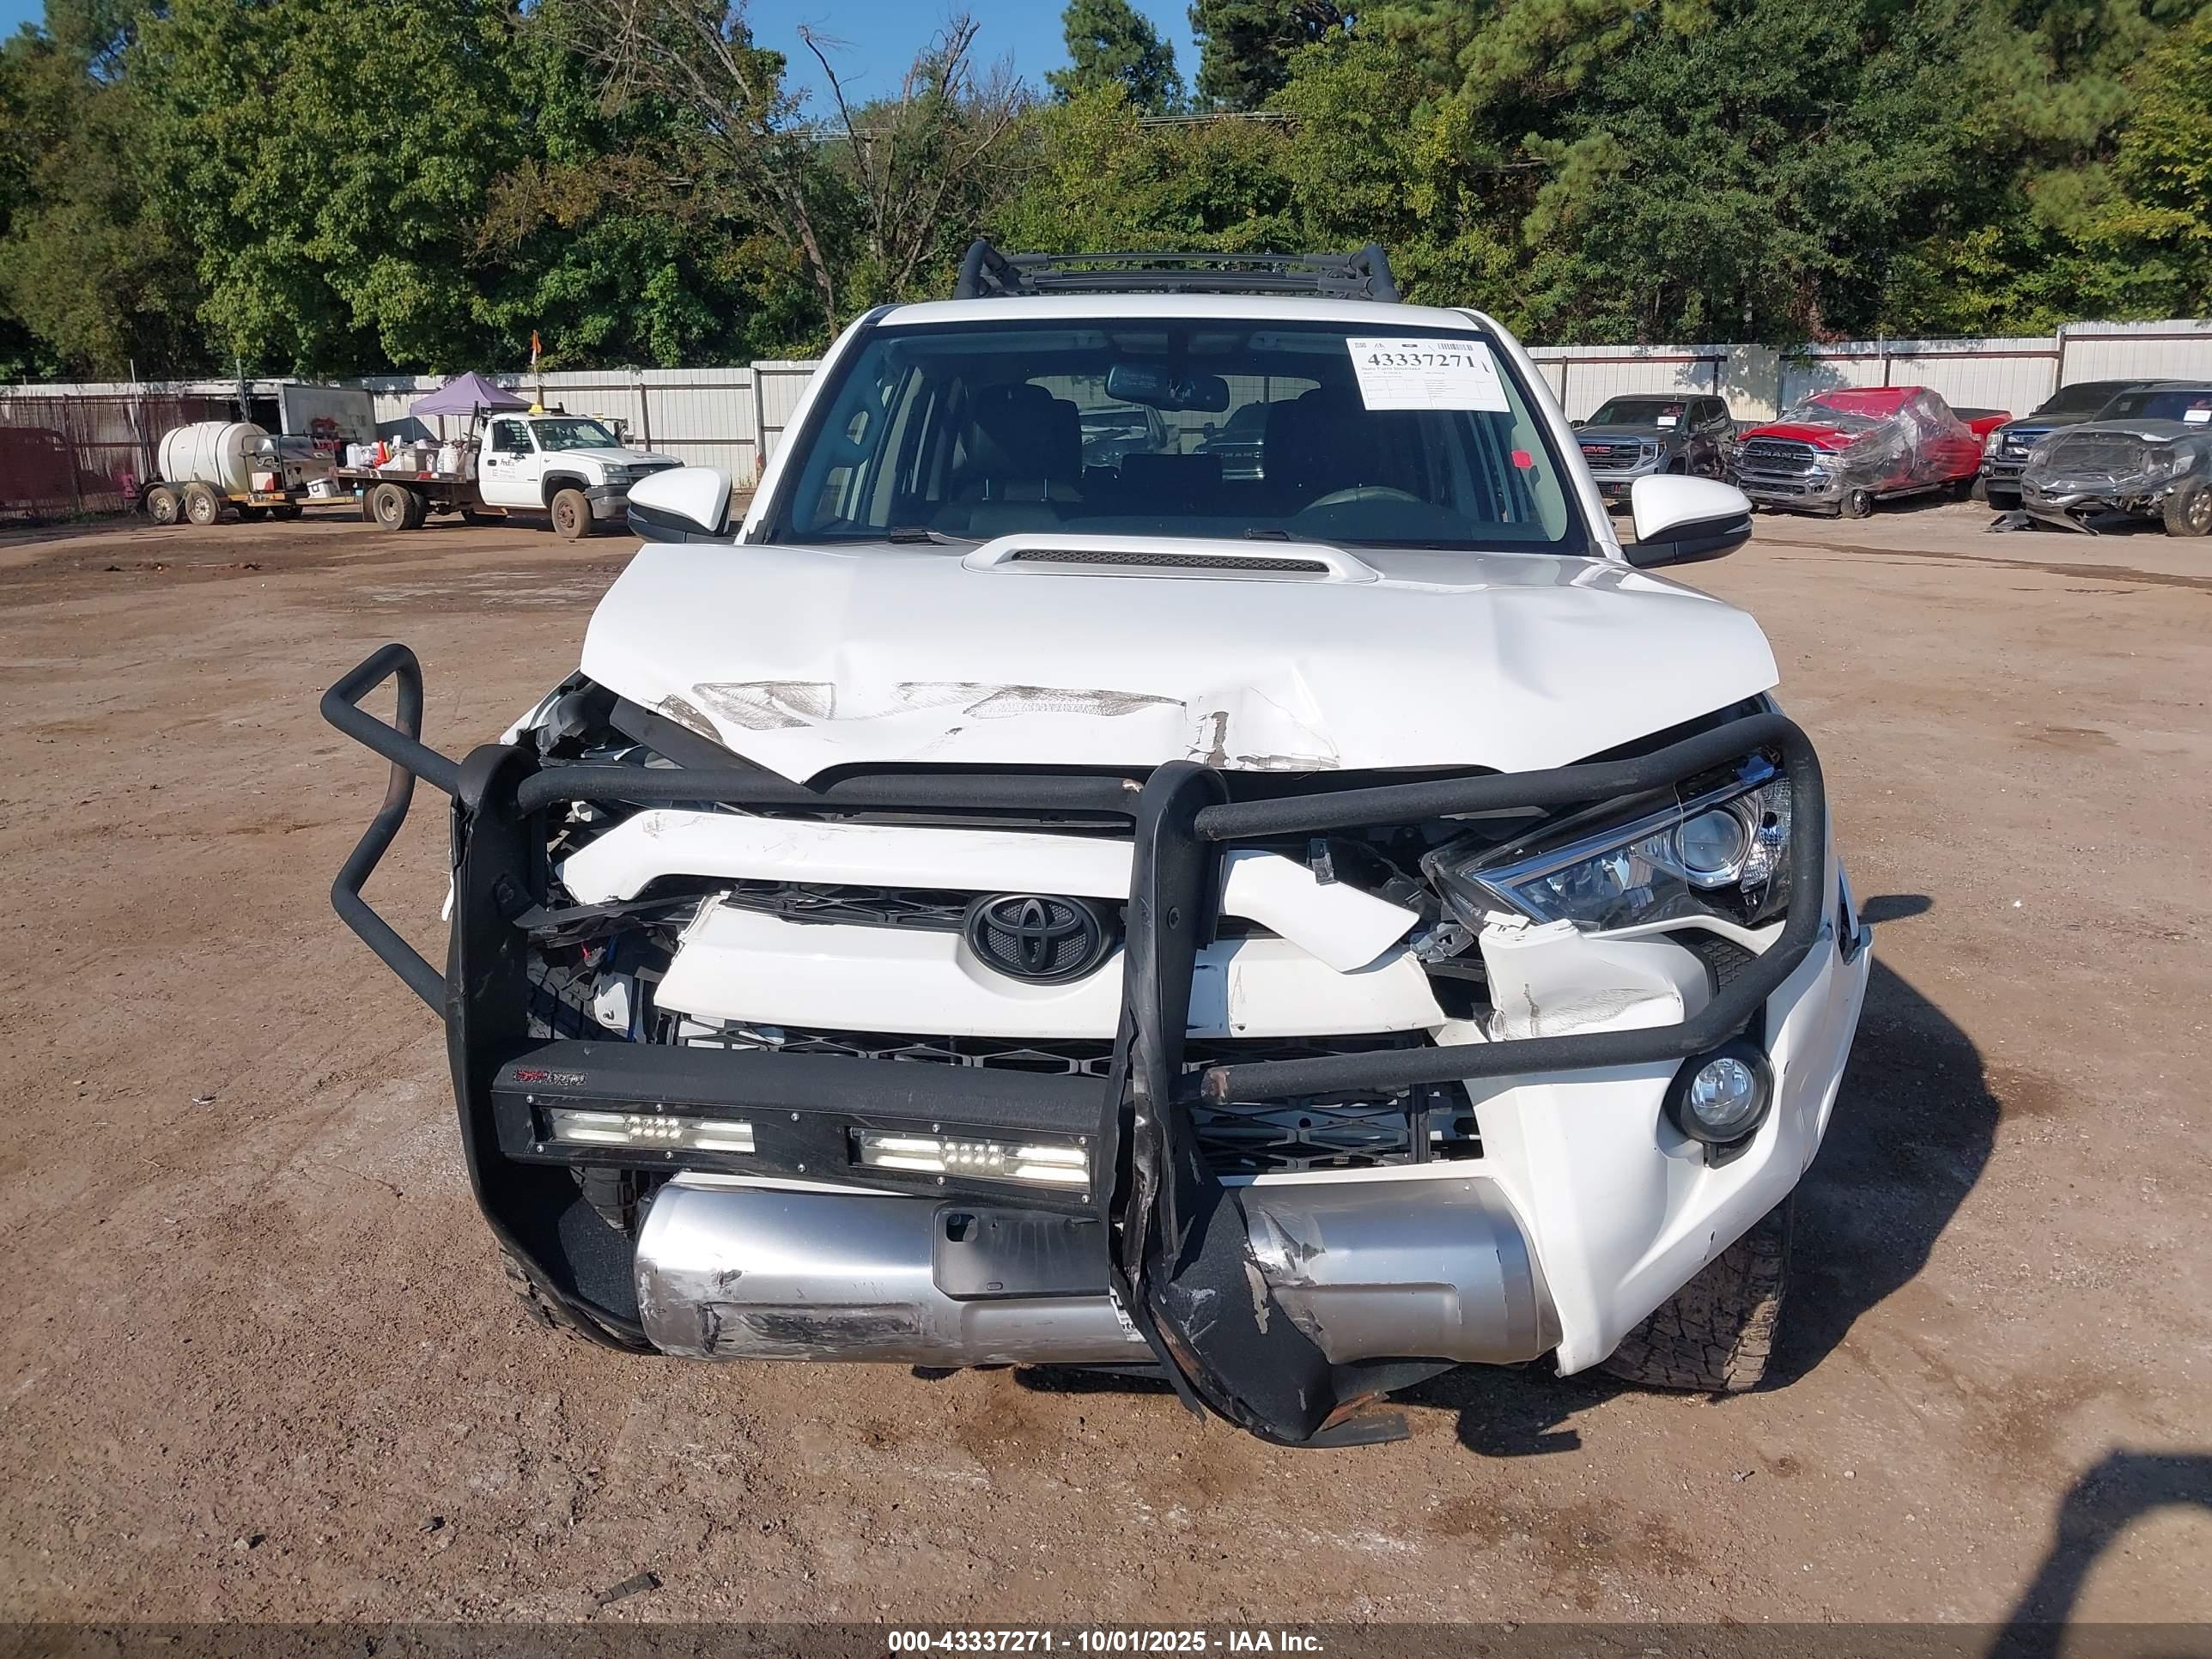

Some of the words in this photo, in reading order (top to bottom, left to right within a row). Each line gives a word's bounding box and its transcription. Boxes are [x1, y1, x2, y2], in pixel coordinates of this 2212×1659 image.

[1368, 353, 1477, 368] 43337271
[1582, 446, 1612, 454] GMC
[1762, 450, 1792, 459] RAM
